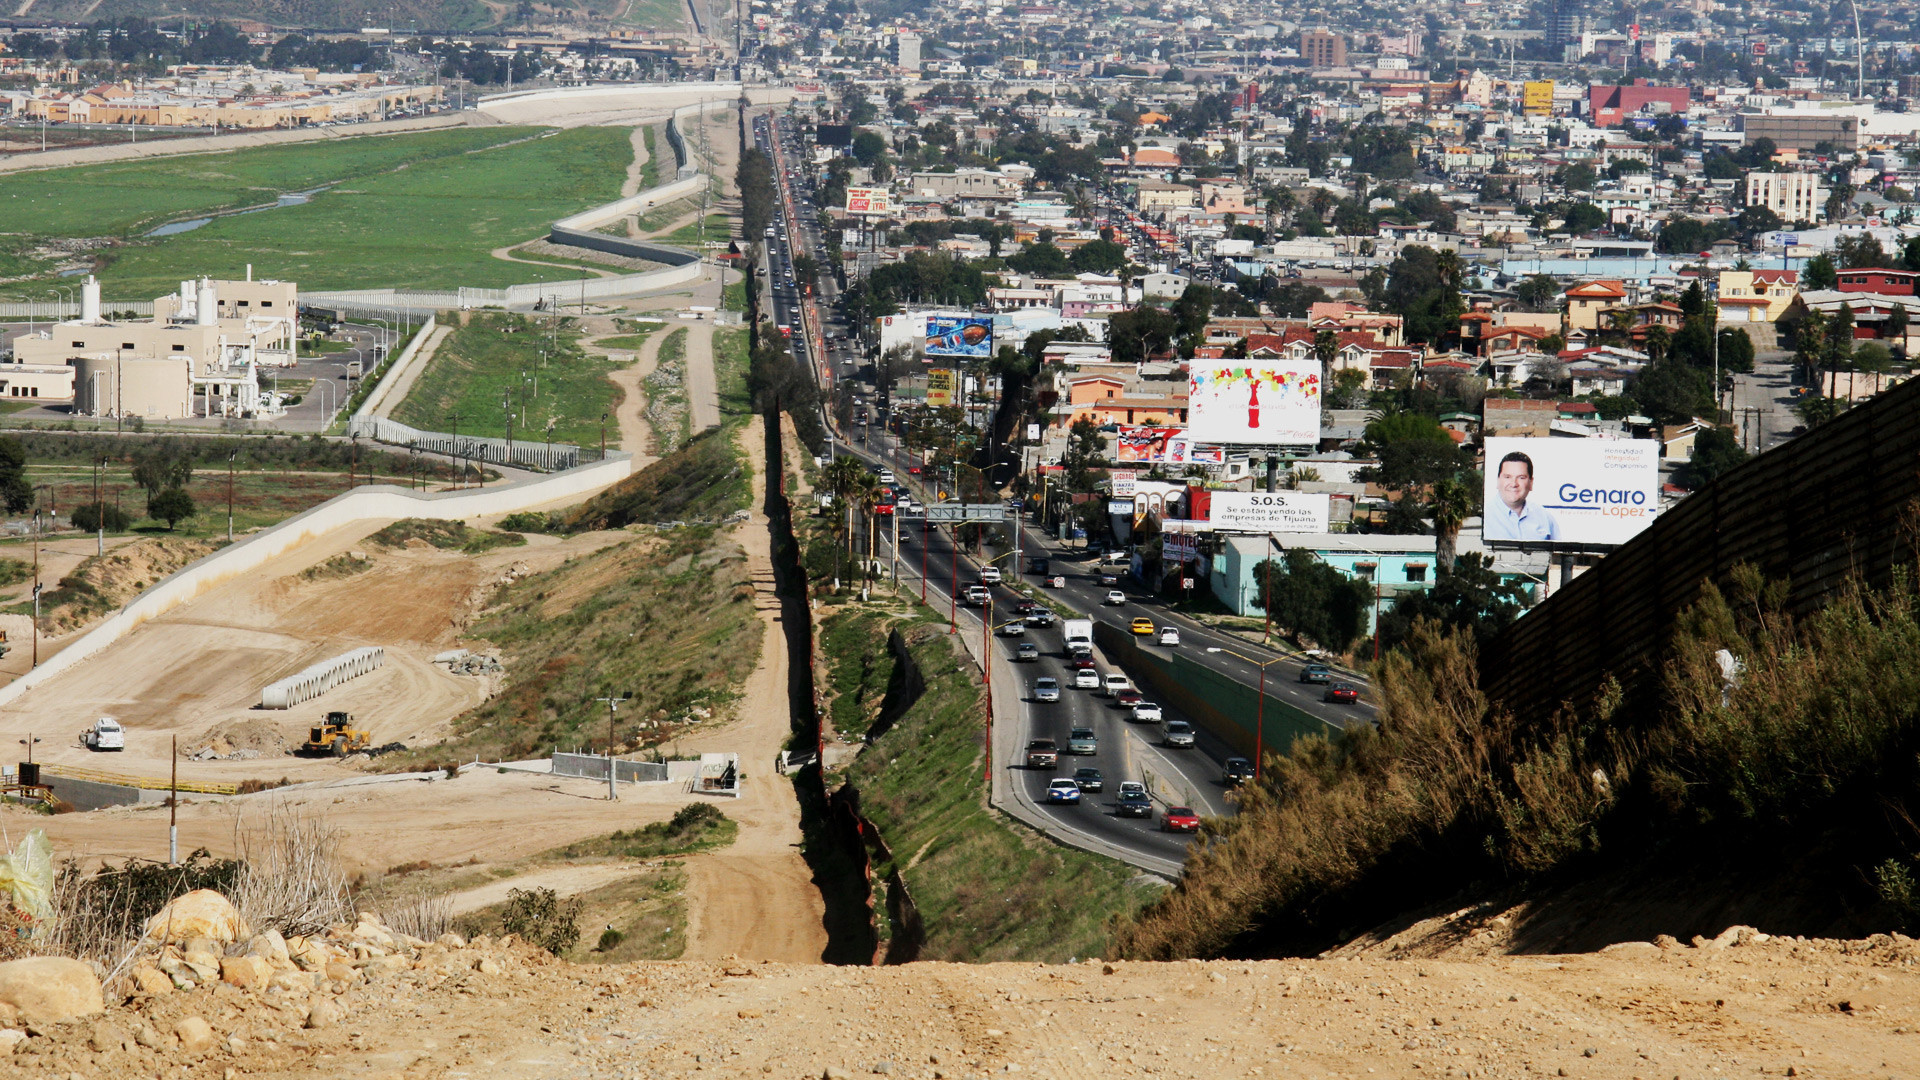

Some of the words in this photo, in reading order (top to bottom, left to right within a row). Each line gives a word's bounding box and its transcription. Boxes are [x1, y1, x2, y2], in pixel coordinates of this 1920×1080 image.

[1558, 483, 1646, 505] Genaro
[1250, 496, 1289, 506] S.O.S.
[1269, 507, 1296, 515] yendo
[1602, 505, 1645, 518] López
[1221, 514, 1266, 522] empresas
[1283, 515, 1317, 523] Tijuana
